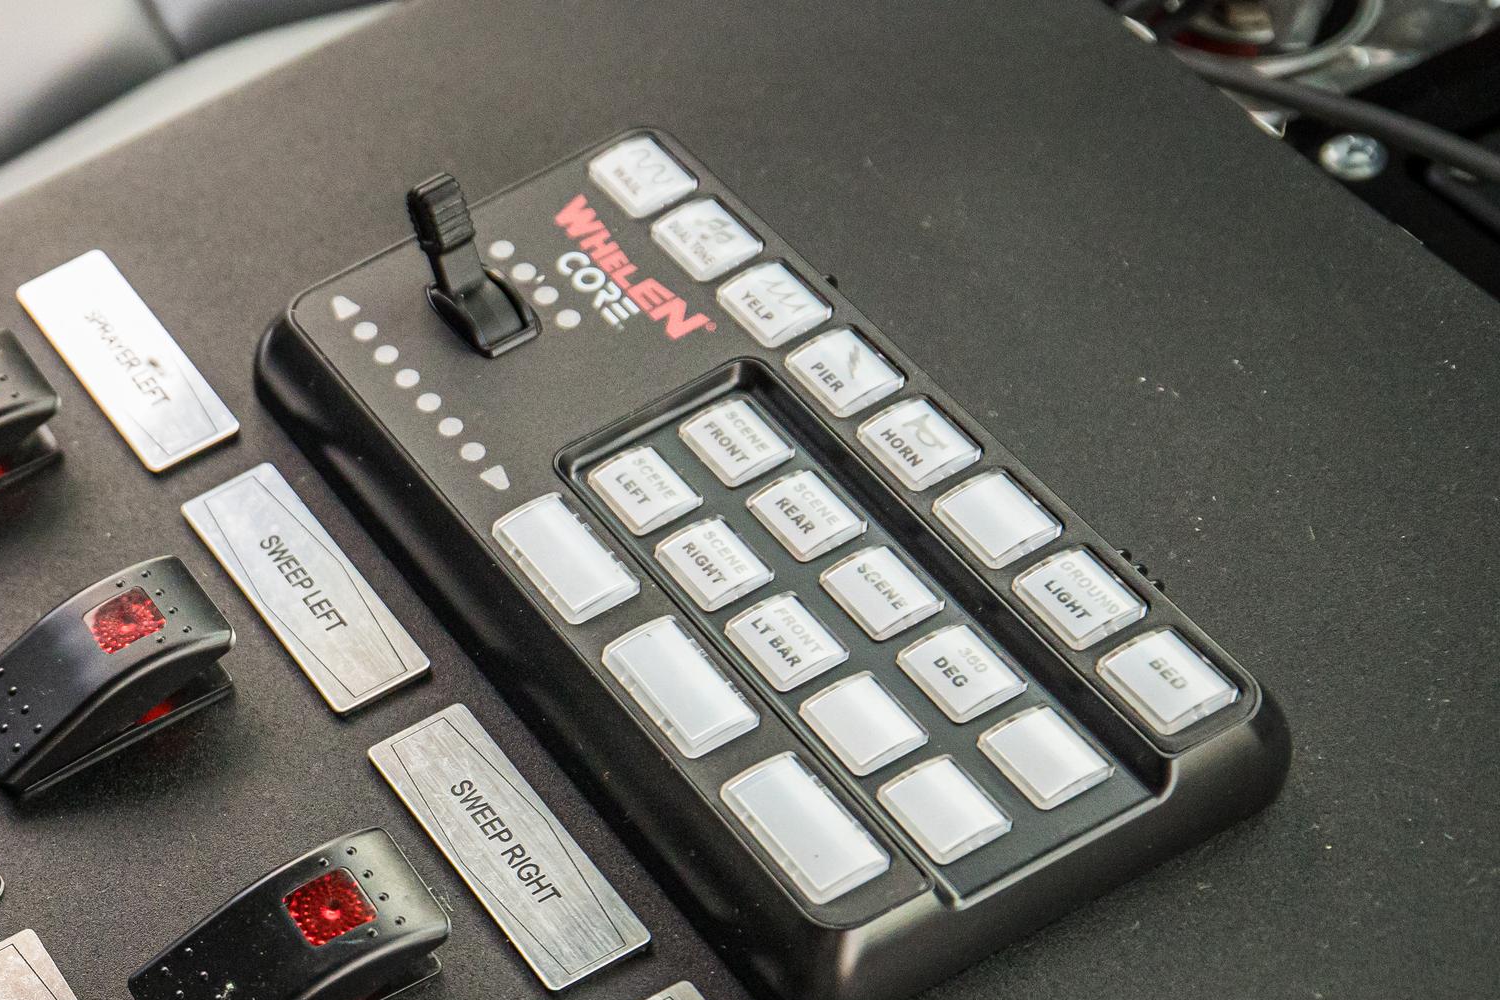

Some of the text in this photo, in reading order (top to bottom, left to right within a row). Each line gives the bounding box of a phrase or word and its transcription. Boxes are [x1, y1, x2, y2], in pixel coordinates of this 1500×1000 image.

[554, 193, 711, 341] WHELEN
[556, 251, 641, 327] CORE
[740, 290, 775, 320] YELP
[810, 361, 845, 393] PIER
[703, 420, 750, 464] FRONT
[725, 410, 769, 453] SCENE
[880, 428, 923, 467] HORN
[615, 472, 651, 506] LEFT
[632, 456, 676, 500] SCENE
[774, 496, 817, 536] REAR
[793, 481, 840, 526] SCENE
[681, 541, 727, 586] RIGHT
[703, 530, 749, 575] SCENE
[260, 535, 348, 632] SWEEP LEFT
[857, 562, 908, 610] SCENE
[1044, 579, 1092, 619] LIGHT
[1059, 560, 1122, 616] GROUND
[751, 617, 802, 668] LT BAR
[774, 606, 824, 653] FRONT
[932, 656, 969, 689] DEG
[957, 646, 988, 674] 360
[1149, 656, 1190, 691] BED
[450, 779, 562, 903] SWEEP RIGHT
